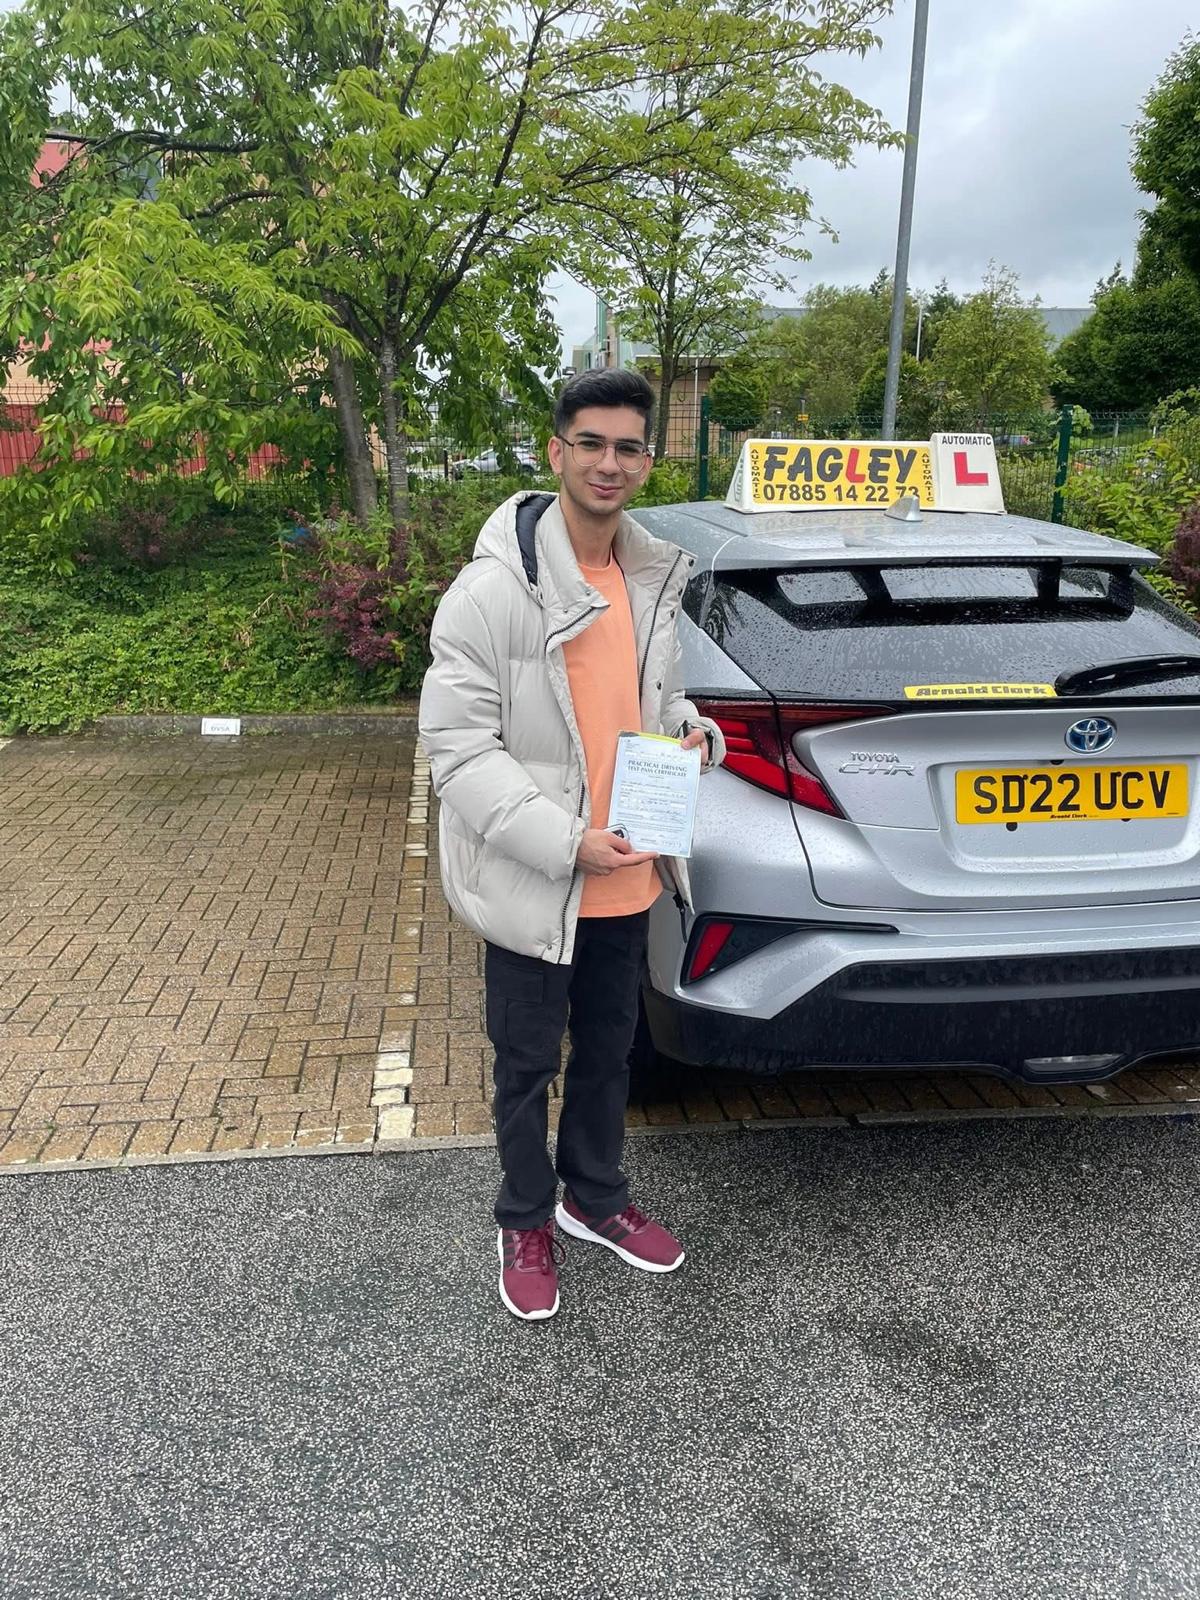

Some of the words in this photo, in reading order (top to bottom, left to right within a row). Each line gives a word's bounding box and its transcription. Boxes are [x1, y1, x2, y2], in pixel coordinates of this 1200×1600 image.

[942, 436, 992, 445] AUTOMATIC
[751, 449, 760, 498] AUTOMATIC
[764, 446, 917, 484] FAGLEY
[954, 452, 989, 486] L
[922, 453, 934, 501] AUTOMATIC
[764, 484, 826, 502] 07885
[834, 484, 858, 502] 14
[865, 485, 890, 502] 22
[916, 686, 988, 696] Arnold
[991, 685, 1047, 695] Clark
[628, 760, 659, 769] PRACTICAL
[662, 763, 688, 772] DRIVING
[850, 751, 900, 763] TOYOTA
[654, 768, 687, 777] CERTIFICATE
[974, 772, 1081, 815] SD22
[1094, 770, 1171, 810] UCV
